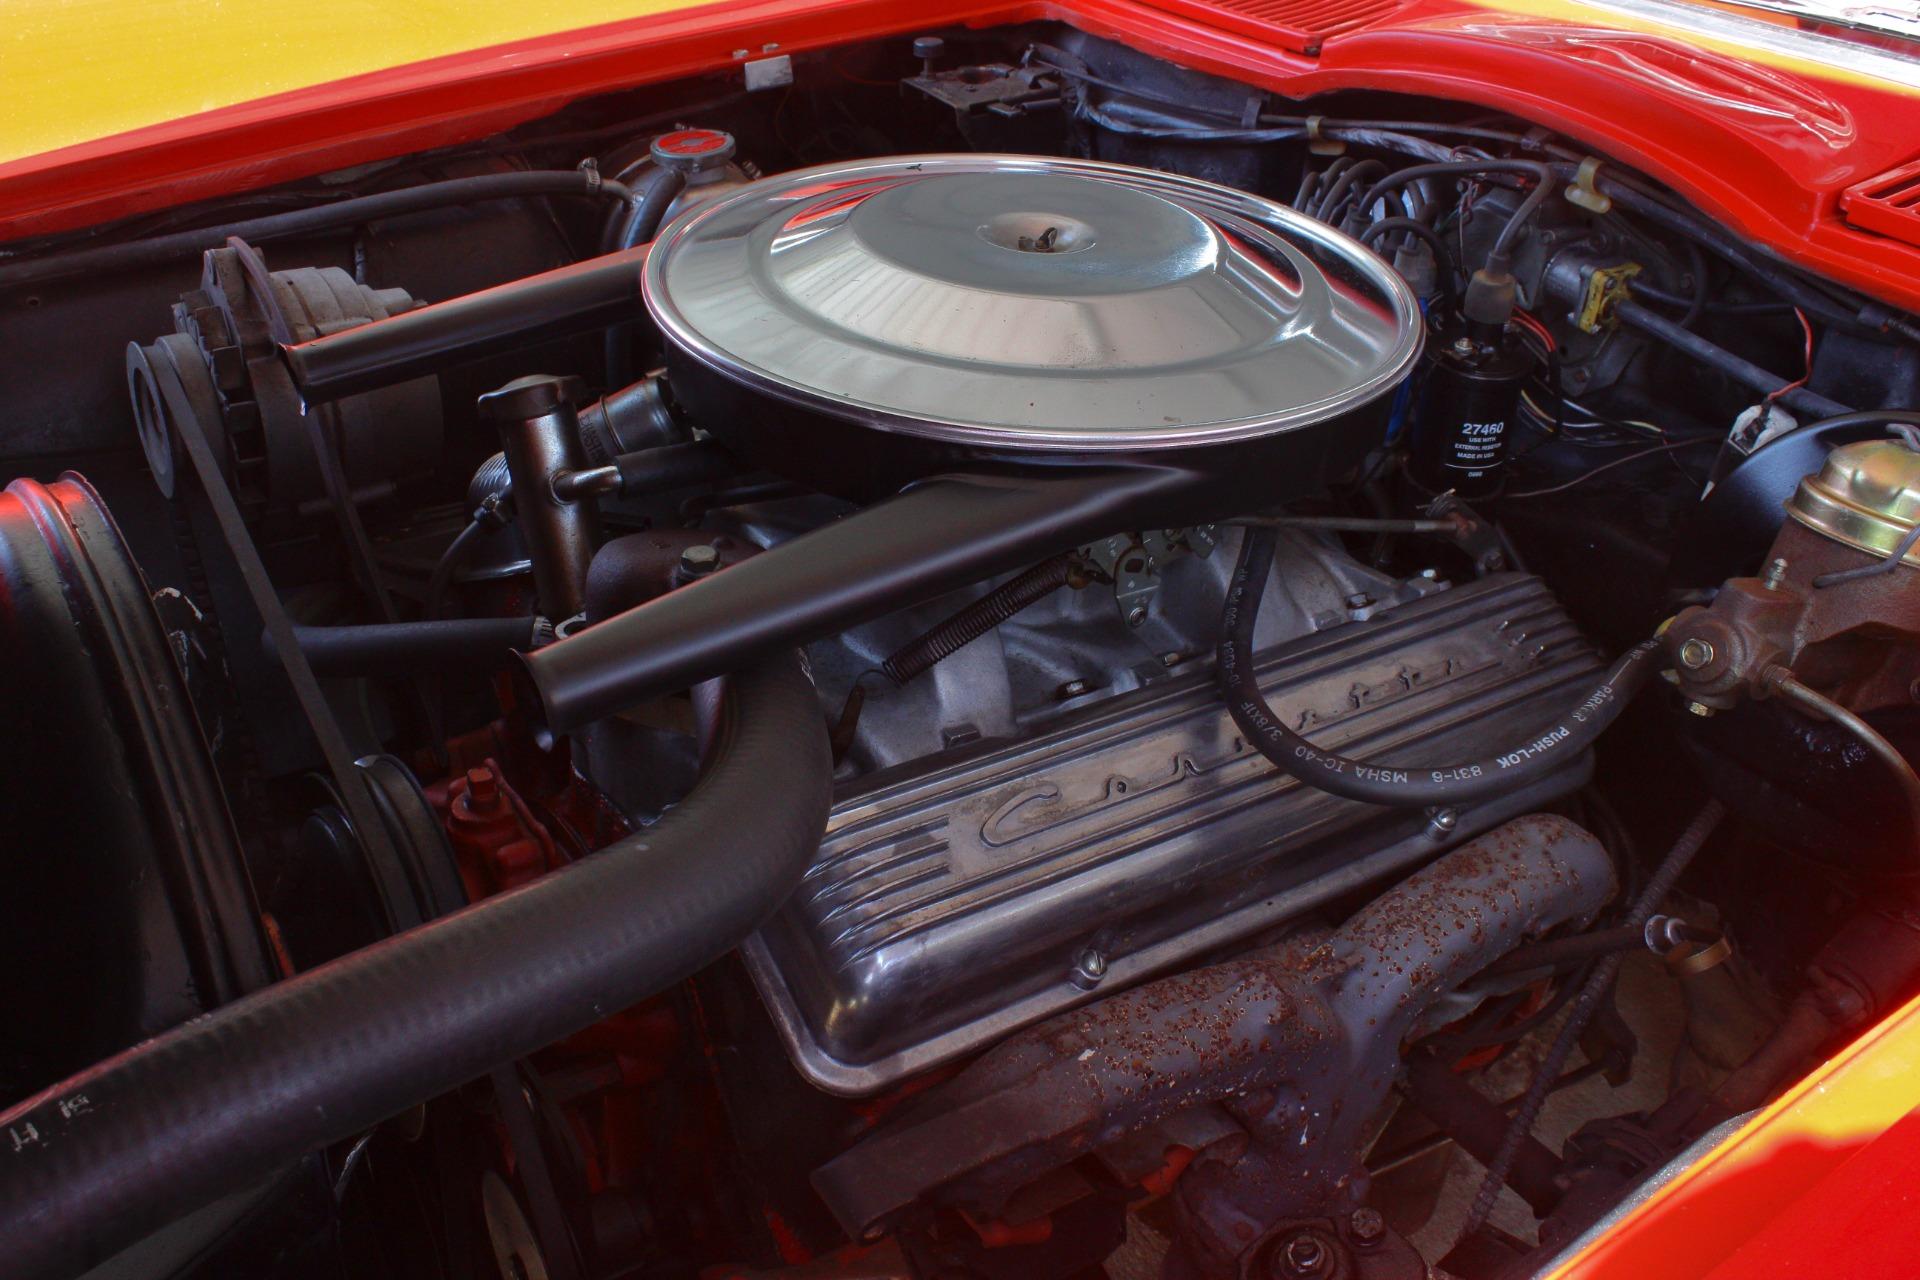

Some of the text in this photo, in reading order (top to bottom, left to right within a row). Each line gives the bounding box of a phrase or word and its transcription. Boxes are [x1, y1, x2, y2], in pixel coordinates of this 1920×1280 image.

[1462, 422, 1504, 435] 27460
[1496, 726, 1571, 769] PUSH-LOK
[1295, 746, 1346, 774] IC-40
[1355, 765, 1408, 785] MSHA
[1431, 765, 1483, 784] 831-6
